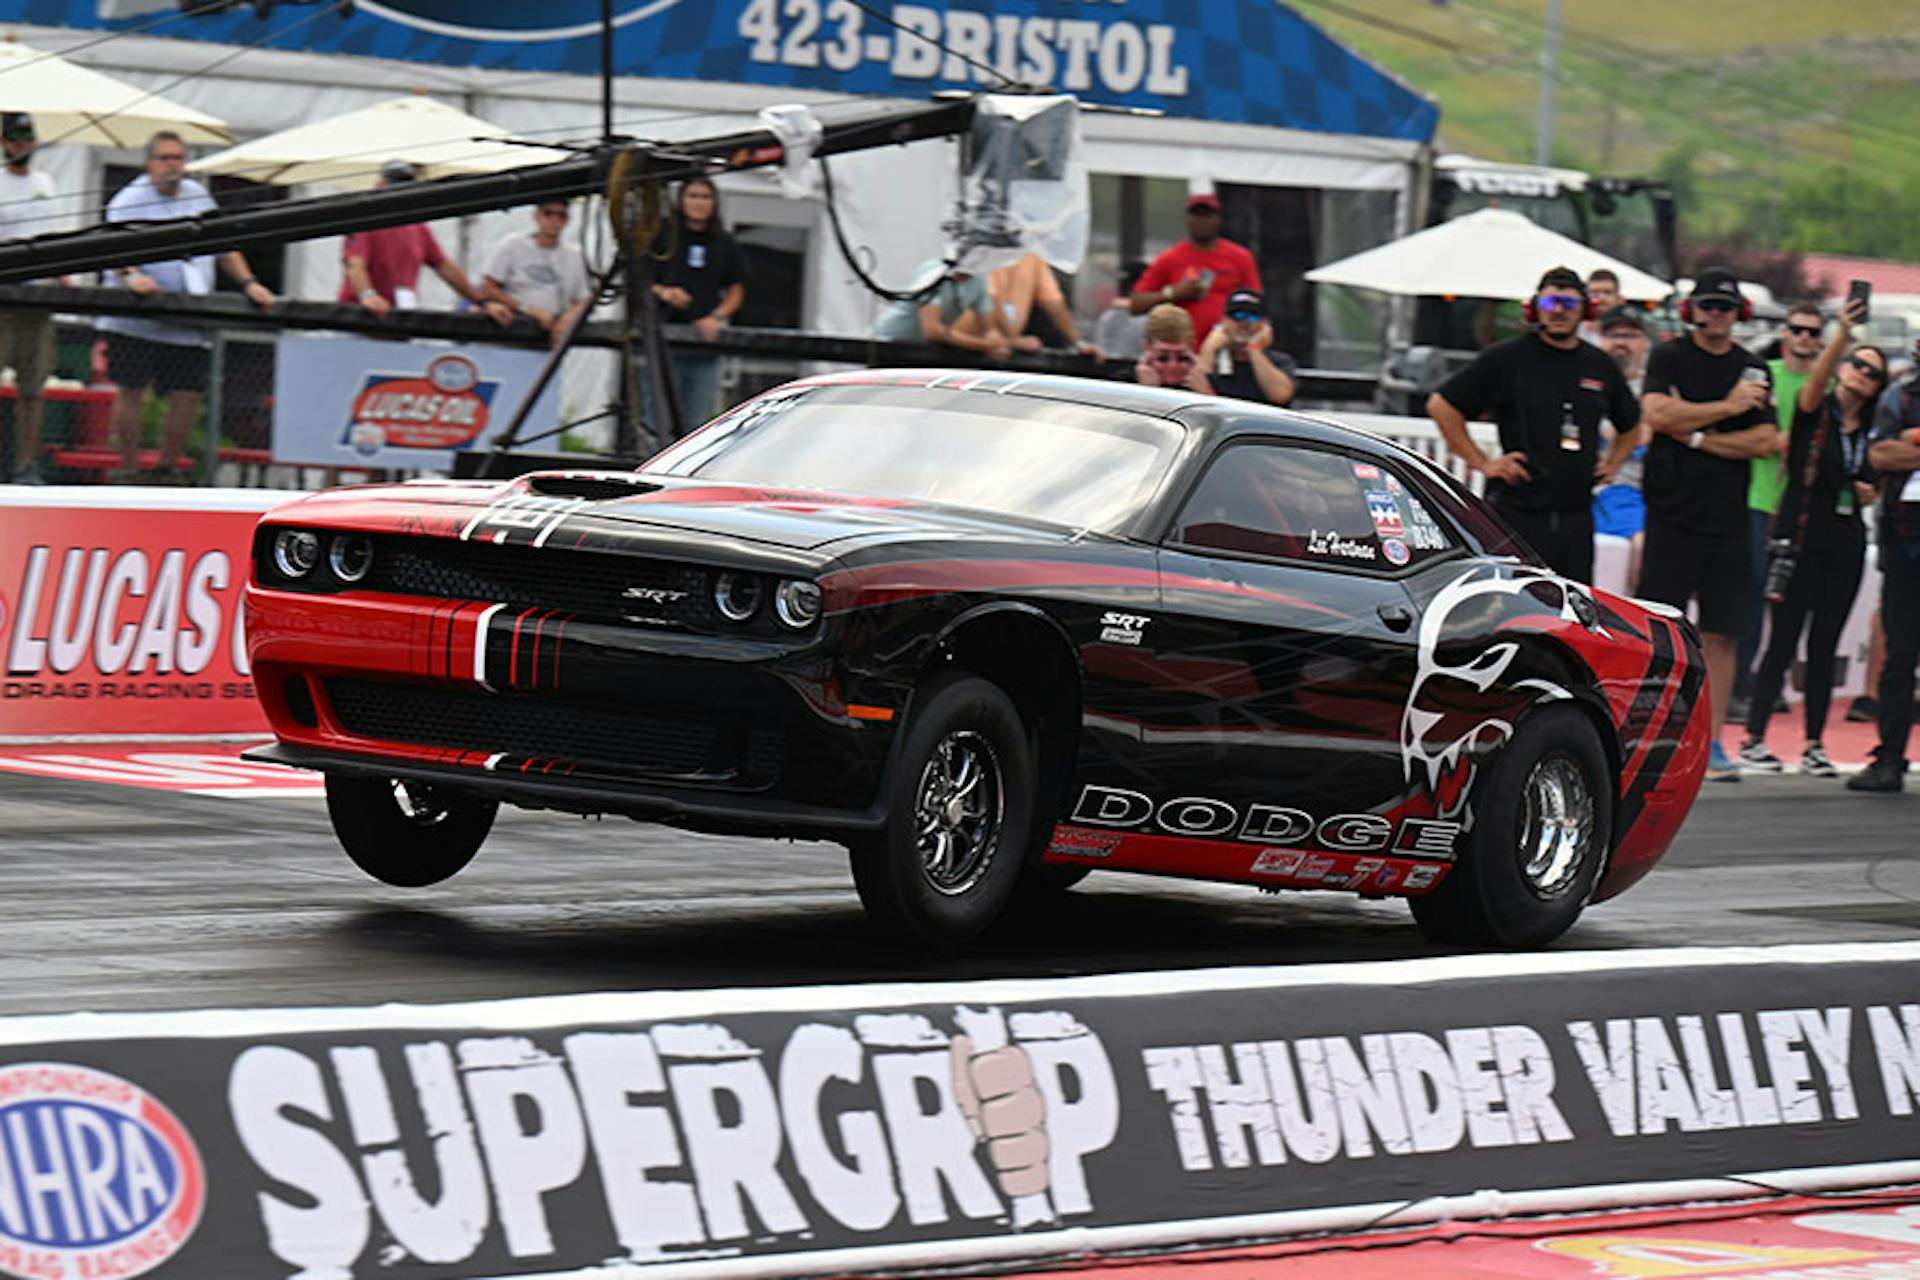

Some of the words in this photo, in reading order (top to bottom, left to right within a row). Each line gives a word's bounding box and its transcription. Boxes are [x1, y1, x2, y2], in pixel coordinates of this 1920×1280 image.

[738, 0, 1188, 96] 423-BRISTOL
[359, 392, 444, 422] LUCAS
[8, 546, 231, 677] LUCAS
[621, 587, 689, 605] SRT
[1100, 611, 1152, 631] SRT
[3, 682, 91, 699] DRAG
[97, 682, 213, 699] RACING
[1070, 784, 1462, 860] DODGE
[1143, 1024, 1574, 1171] THUNDER
[1570, 1007, 1860, 1137] VALLEY
